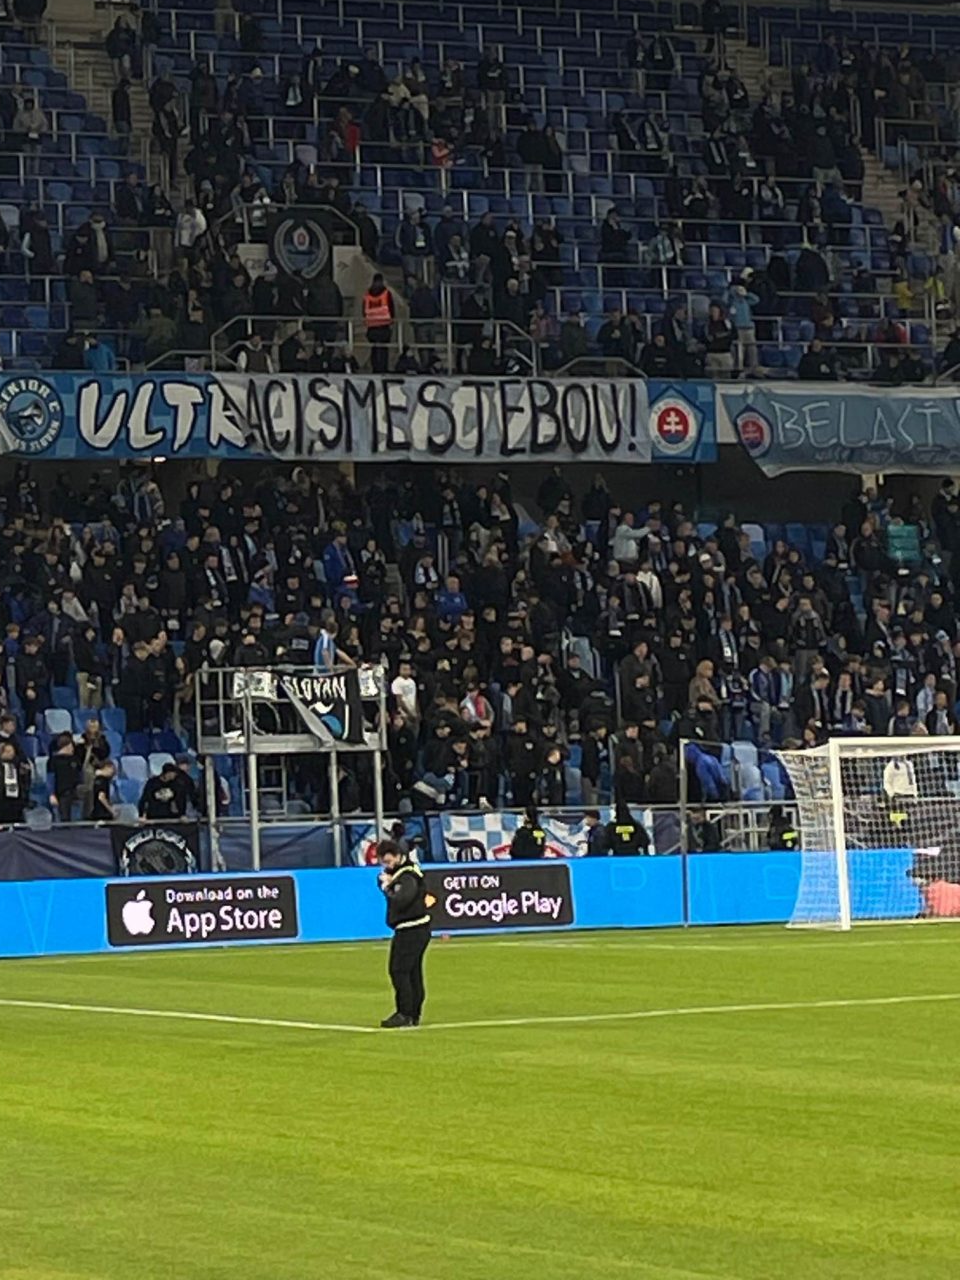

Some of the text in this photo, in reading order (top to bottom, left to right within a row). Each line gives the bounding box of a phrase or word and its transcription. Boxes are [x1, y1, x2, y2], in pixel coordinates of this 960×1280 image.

[283, 676, 346, 703] SLOVAN
[165, 884, 279, 903] Download on the
[443, 875, 500, 890] GET IT ON
[445, 890, 562, 922] Google Play
[166, 905, 282, 938] App Store
